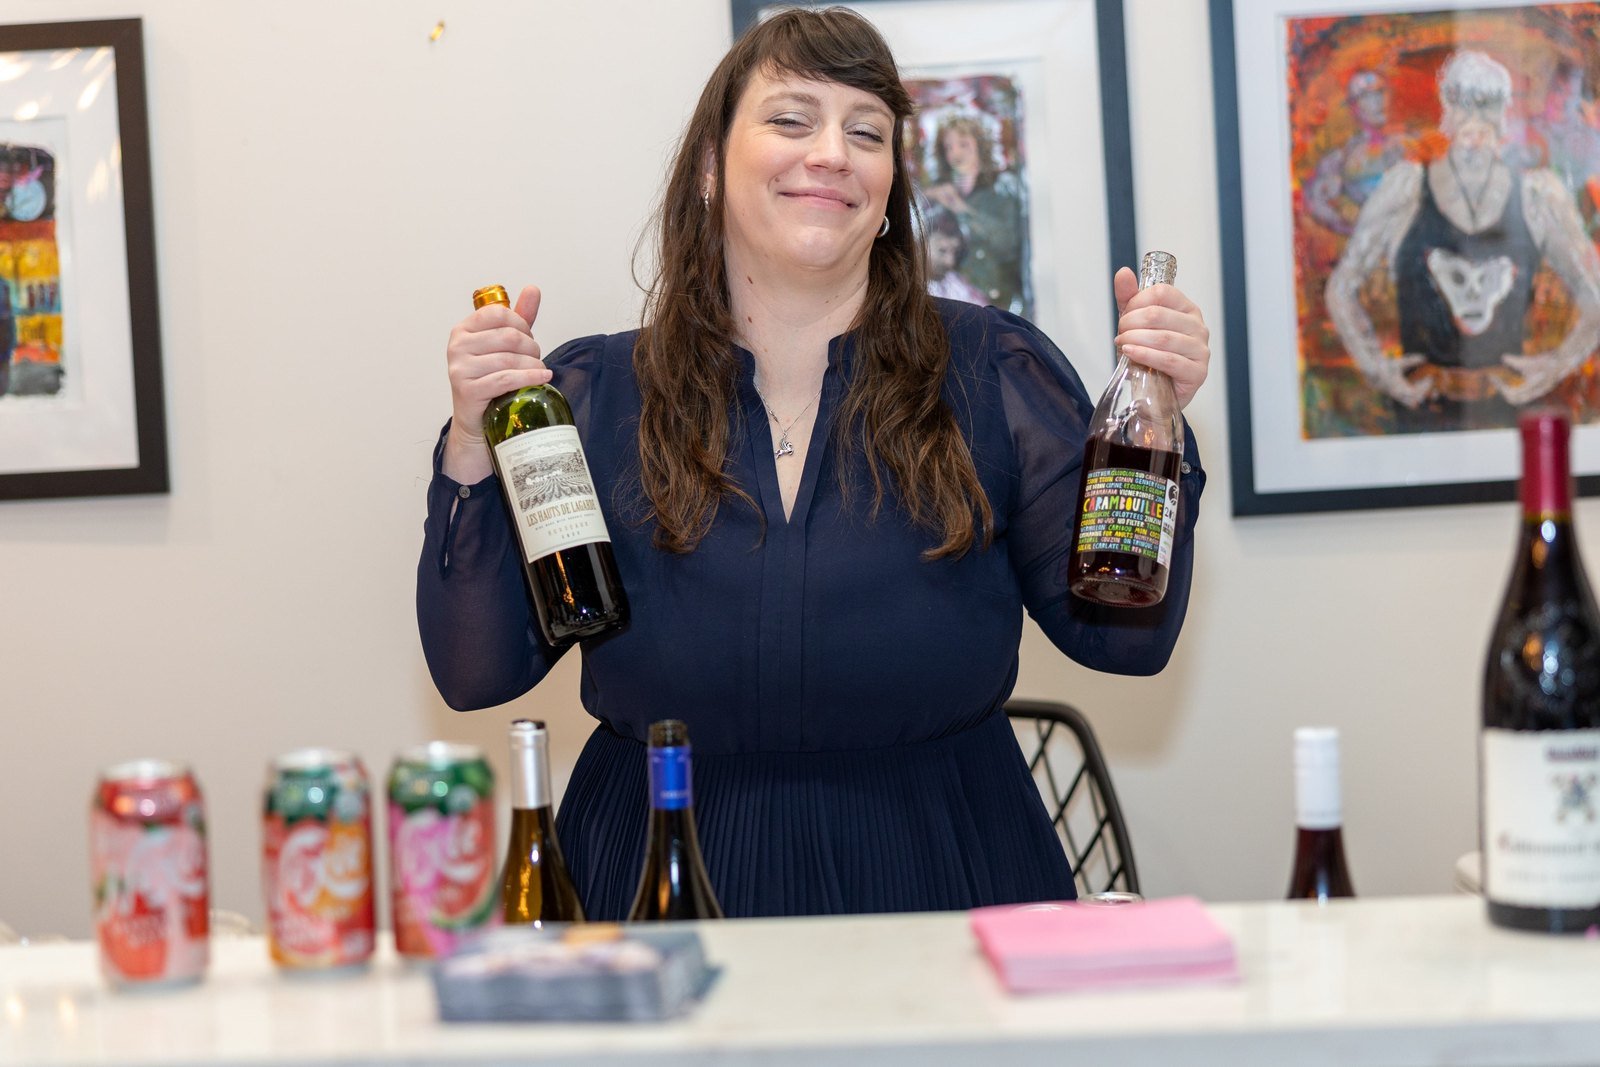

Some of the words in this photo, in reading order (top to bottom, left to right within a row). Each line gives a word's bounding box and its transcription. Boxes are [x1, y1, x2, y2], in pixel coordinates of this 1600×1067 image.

[526, 513, 538, 527] LES
[537, 505, 561, 522] HAUTS
[561, 503, 572, 515] DE
[571, 499, 596, 512] LAGARDE
[1083, 495, 1163, 519] CARAMBOUILLE
